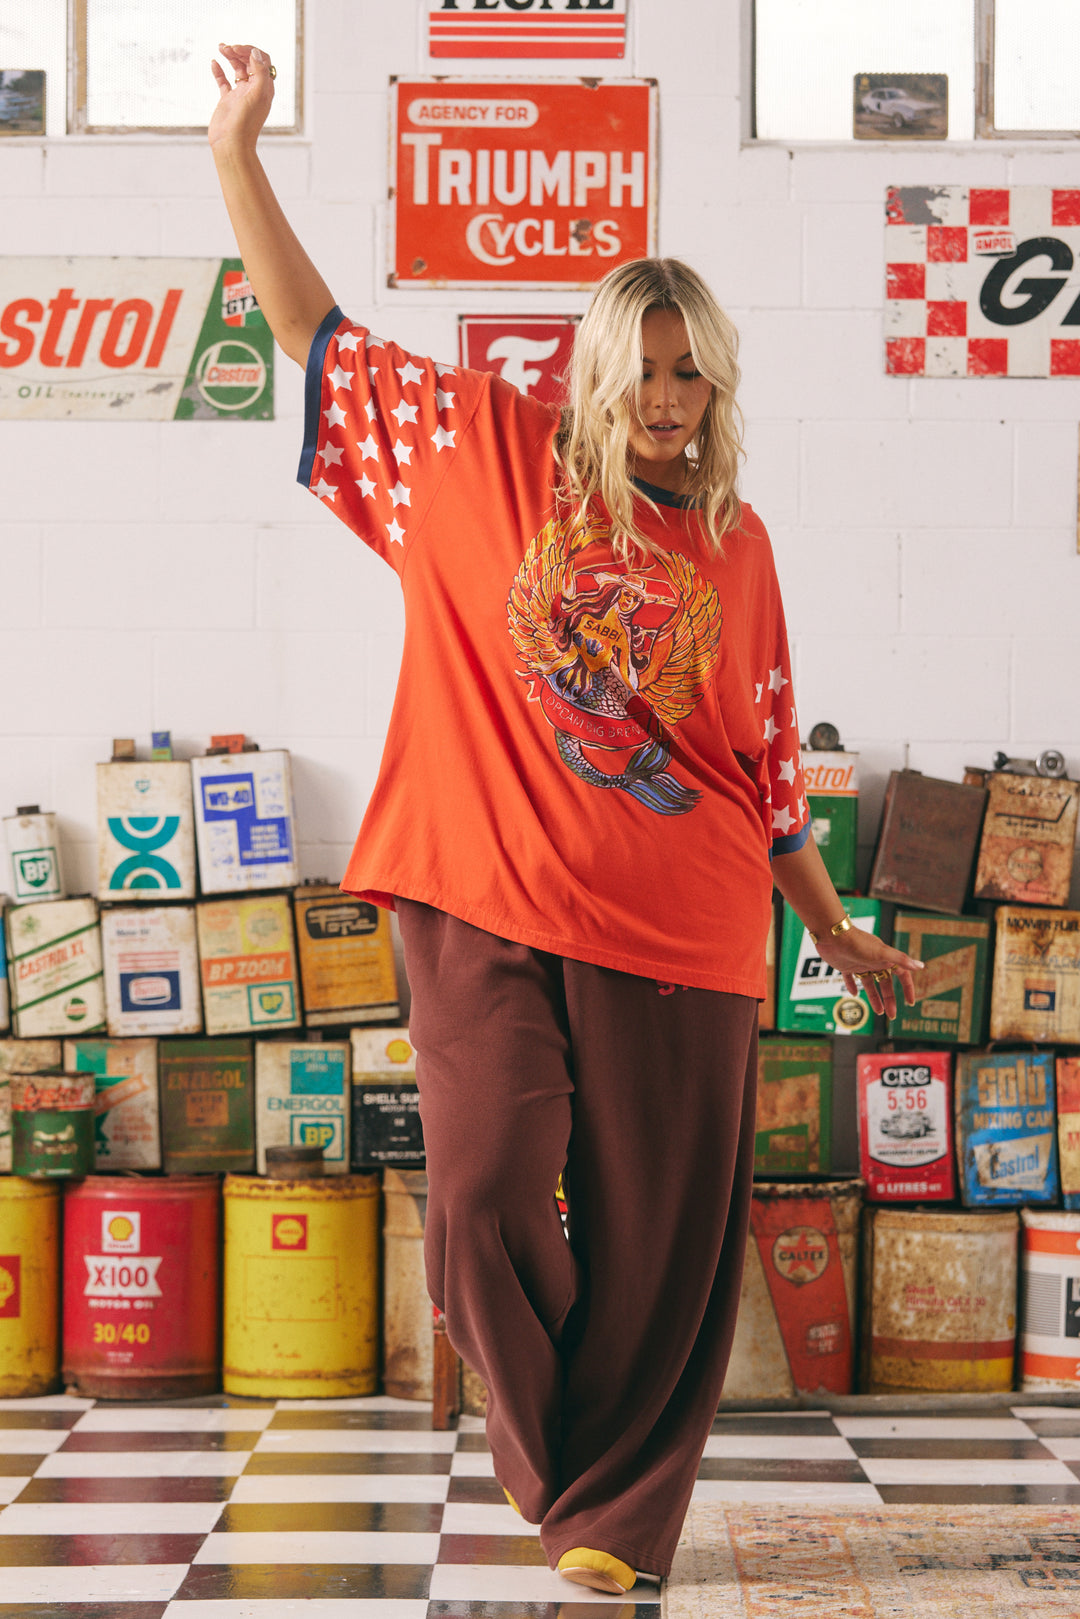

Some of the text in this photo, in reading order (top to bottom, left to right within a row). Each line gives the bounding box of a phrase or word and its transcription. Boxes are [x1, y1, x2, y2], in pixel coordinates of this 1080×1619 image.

[418, 105, 528, 121] AGENCY FOR
[401, 132, 645, 208] TRIUMPH
[466, 213, 622, 266] CYCLES
[976, 238, 1013, 250] AMPOL
[208, 366, 262, 383] Castrol
[18, 386, 54, 398] OIL
[584, 620, 623, 642] SABBI
[586, 721, 605, 737] BIG
[208, 788, 251, 807] WD-40
[24, 860, 49, 881] BP
[208, 957, 287, 981] BP ZOOM
[262, 995, 282, 1010] BP
[882, 1066, 930, 1085] CRC
[267, 1097, 343, 1111] ENERGOL
[363, 1092, 398, 1105] SHELL
[973, 1110, 1053, 1129] MIXING CAN
[304, 1126, 333, 1146] BP
[990, 1144, 1039, 1180] Castrol
[886, 1181, 928, 1194] LITRES
[779, 1252, 824, 1261] CALTEX
[88, 1298, 154, 1310] MOTOR OIL
[93, 1322, 150, 1345] 30/40
